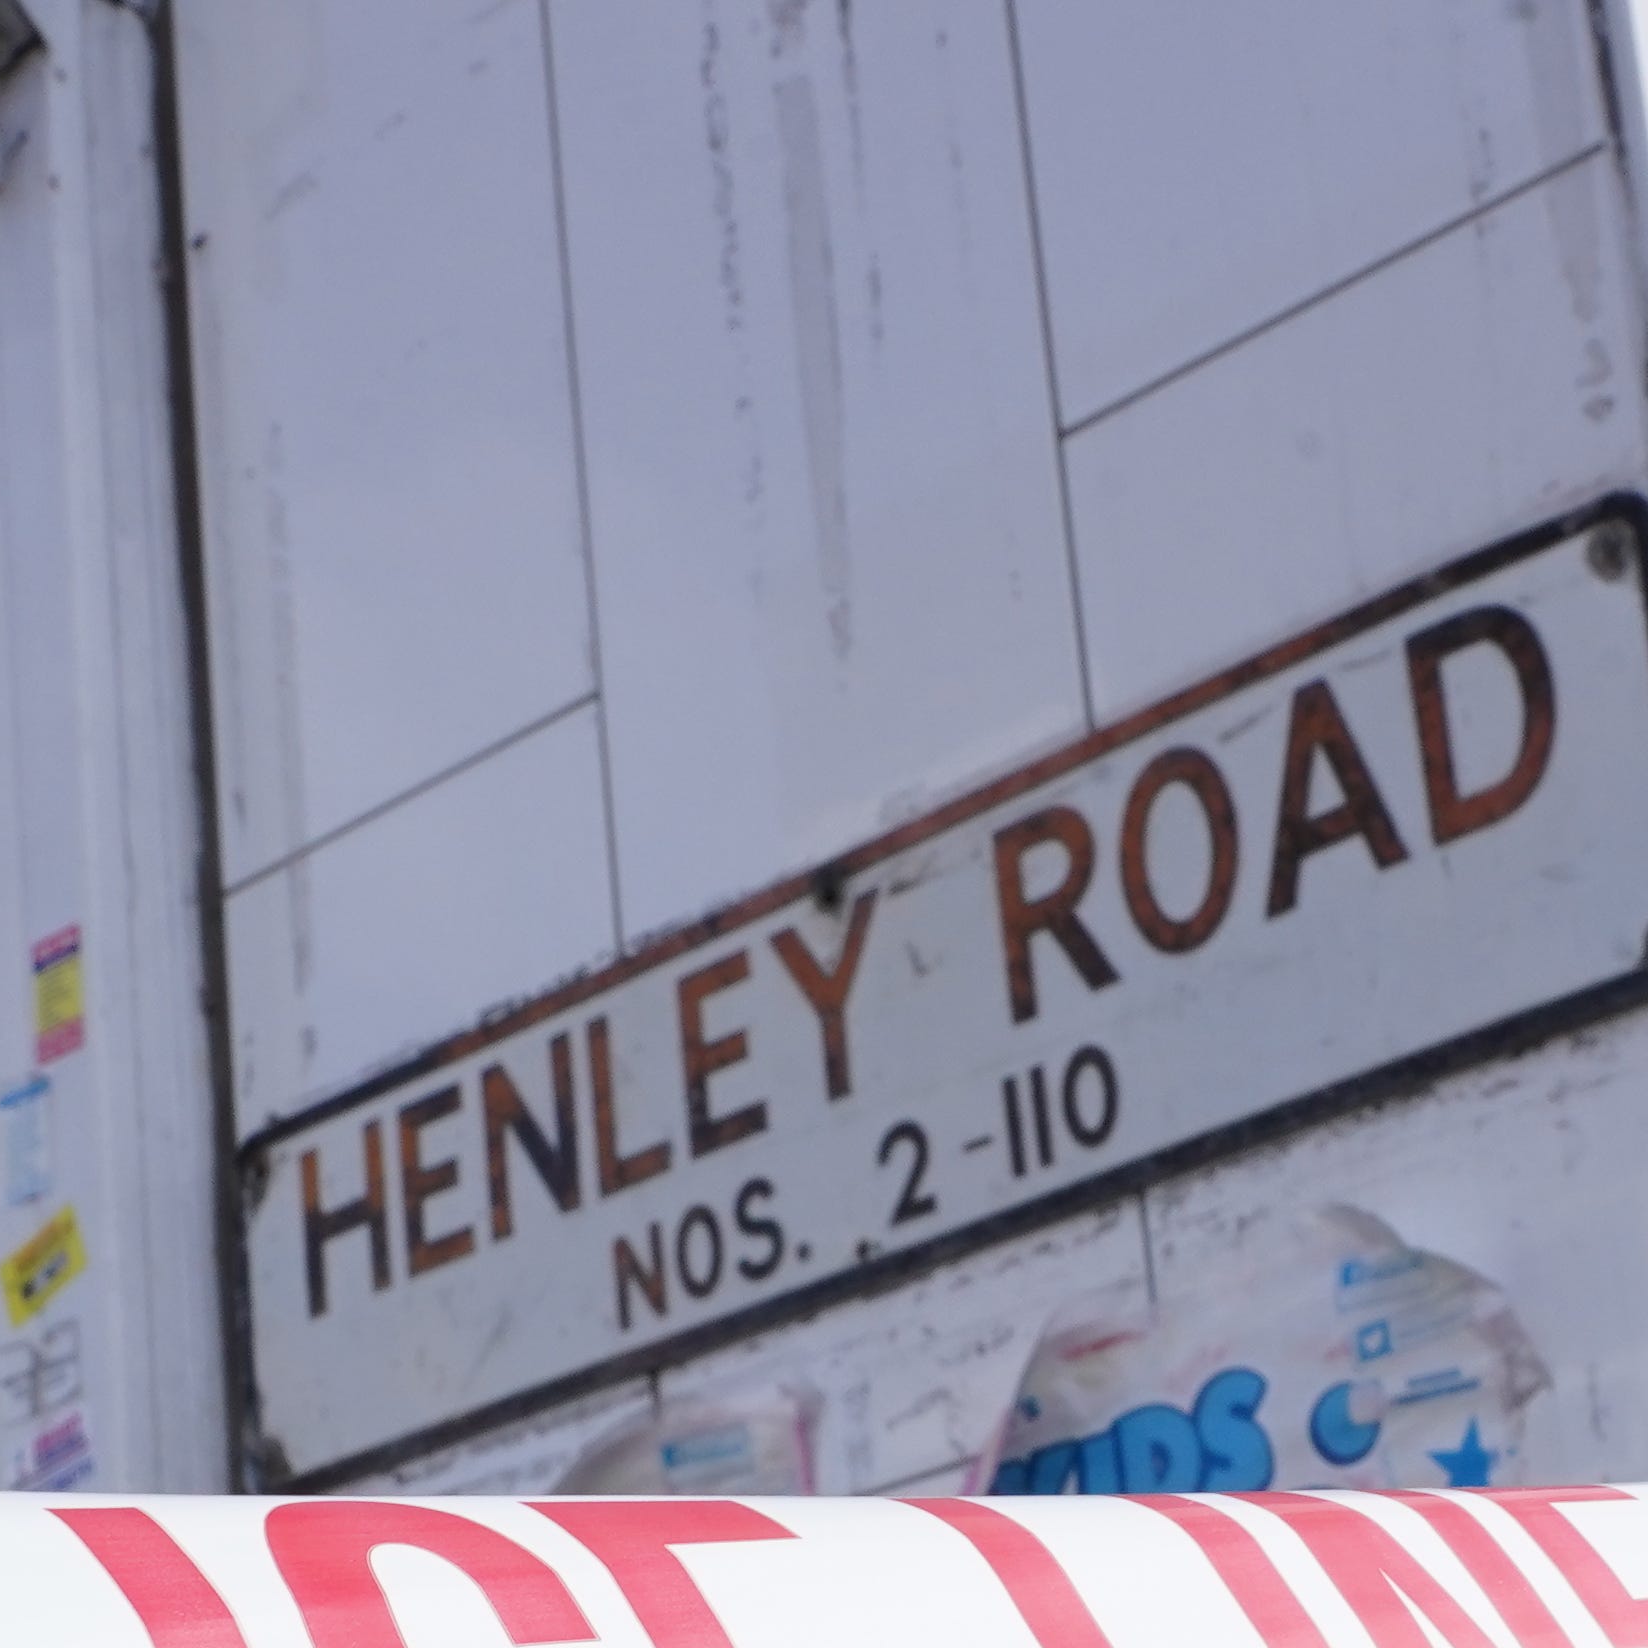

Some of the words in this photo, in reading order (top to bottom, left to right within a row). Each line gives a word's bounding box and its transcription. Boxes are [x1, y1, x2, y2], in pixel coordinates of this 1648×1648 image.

[297, 887, 880, 1320] HENLEY
[990, 602, 1560, 1026] ROAD
[611, 1176, 811, 1332] NOS.
